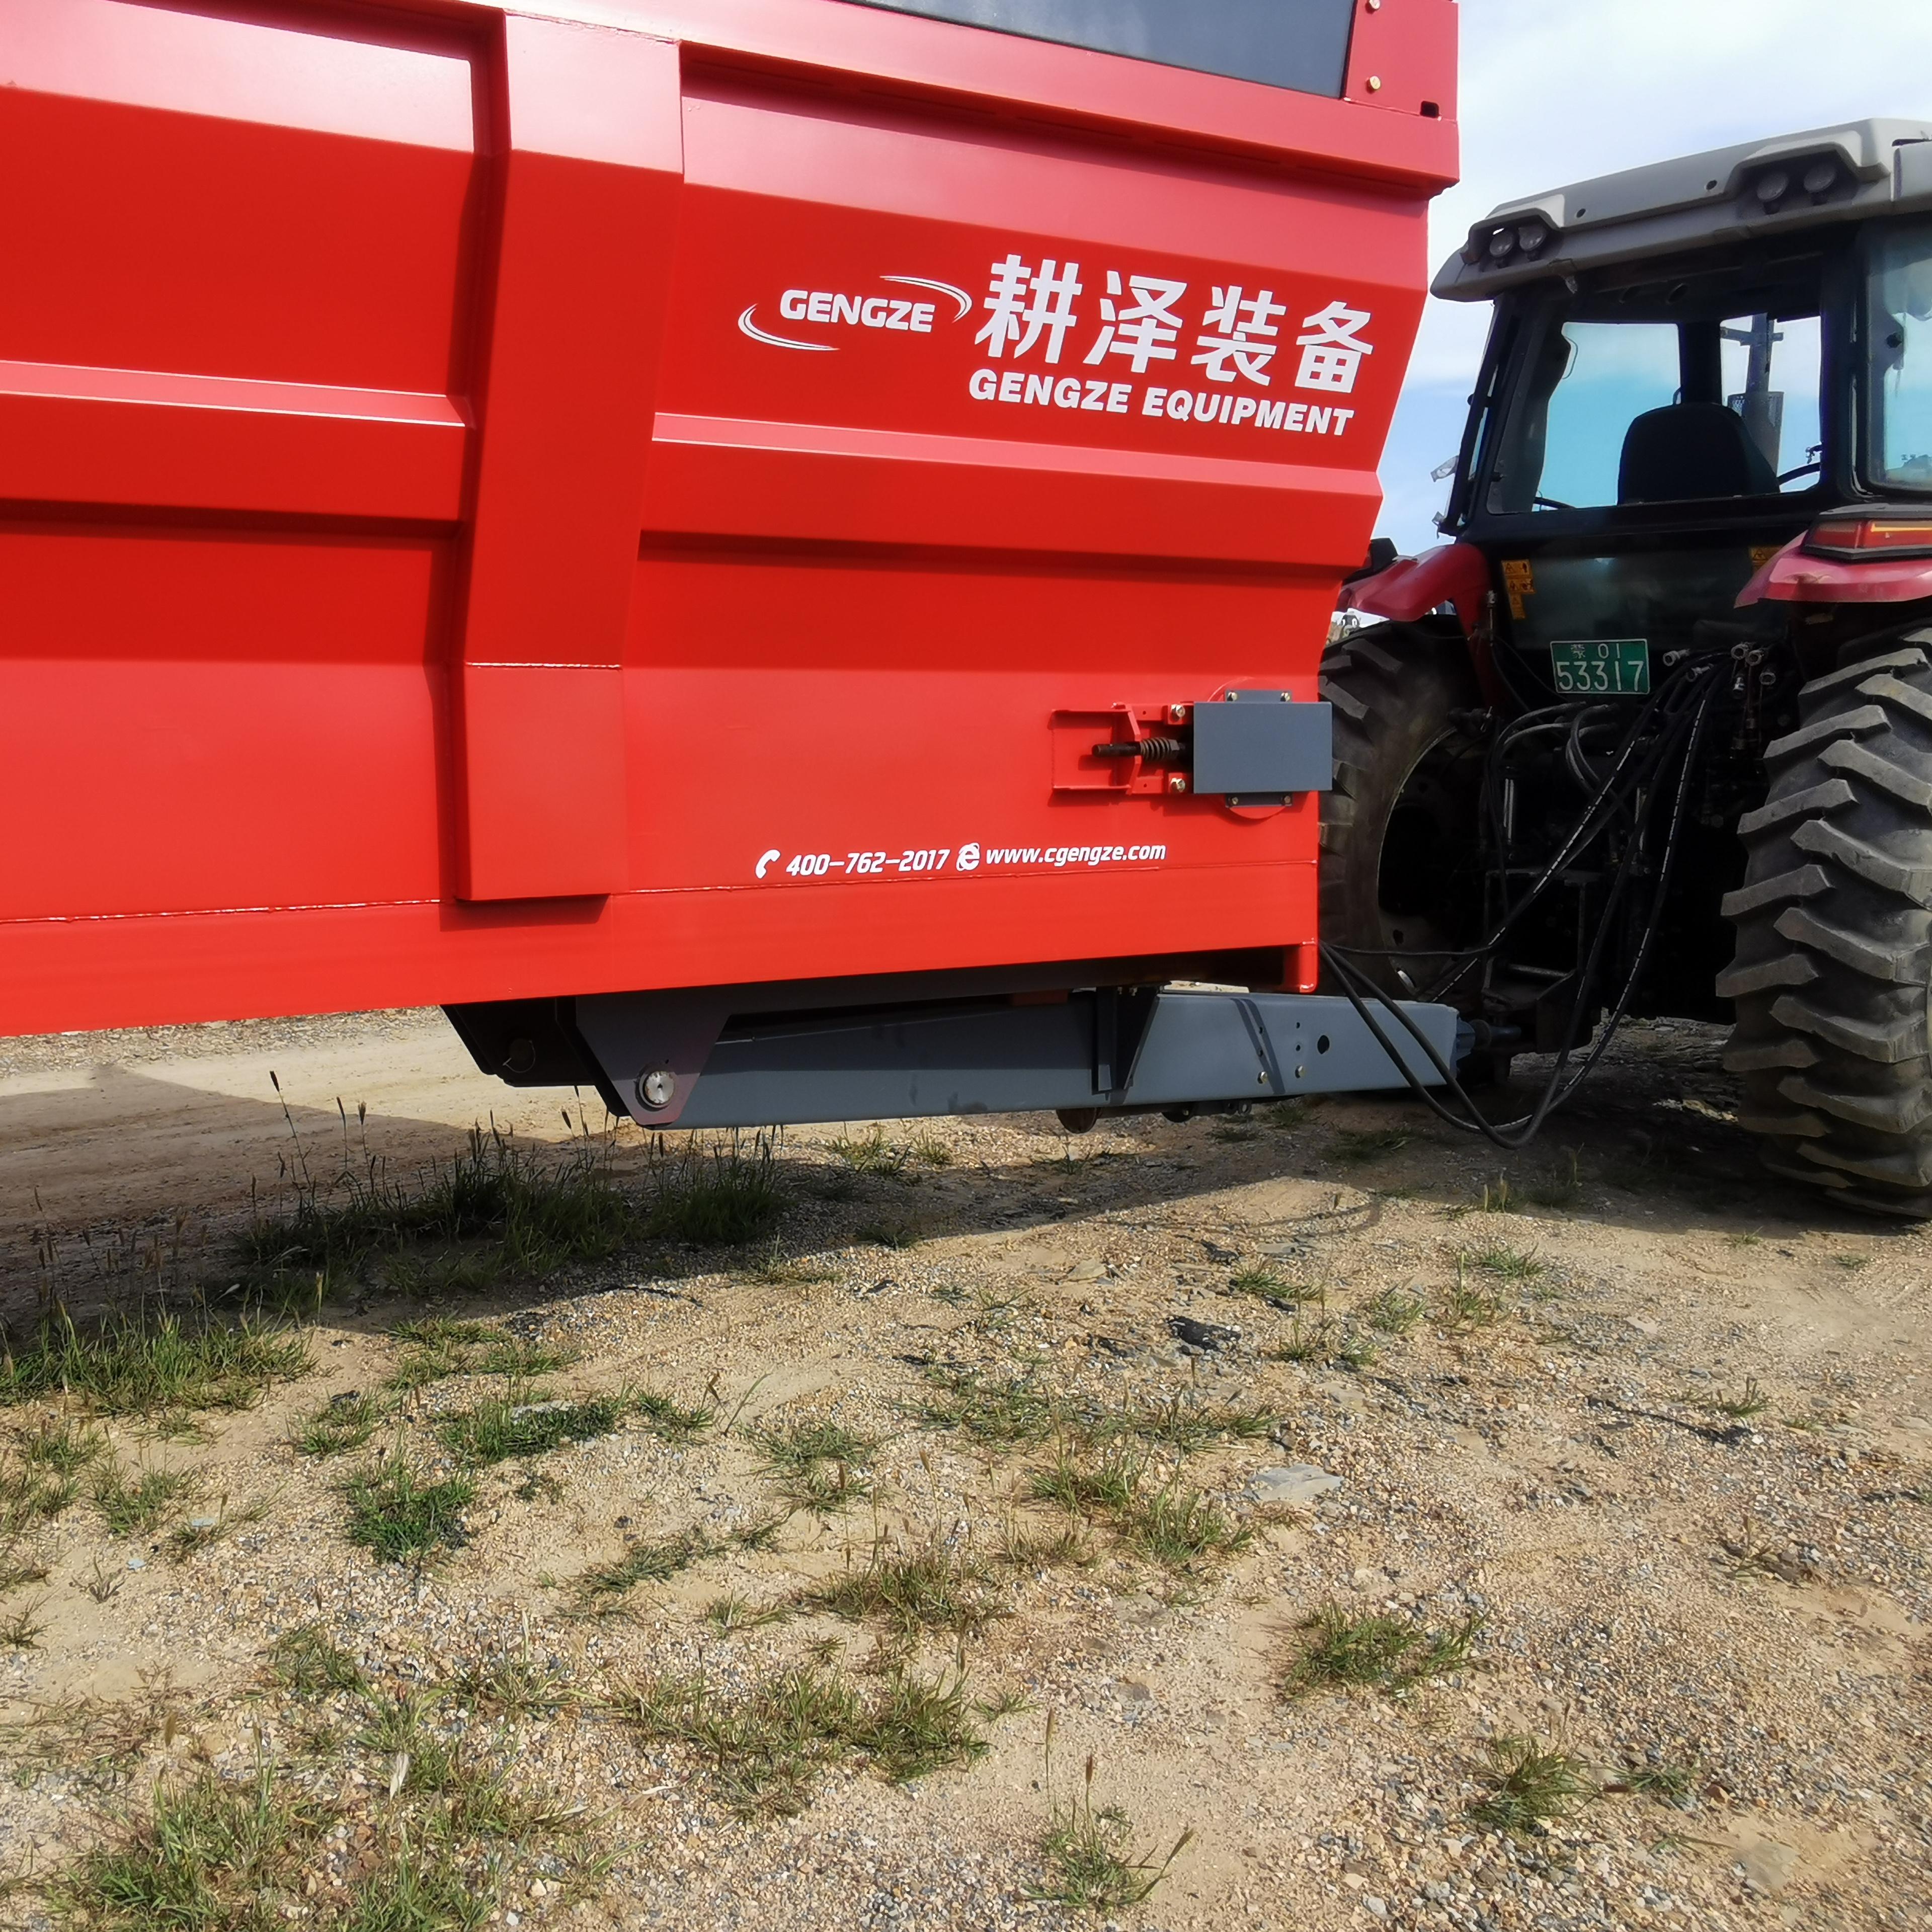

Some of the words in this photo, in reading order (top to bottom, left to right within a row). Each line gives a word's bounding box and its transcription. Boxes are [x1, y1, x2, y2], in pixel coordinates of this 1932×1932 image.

[779, 289, 936, 333] GENGZE
[974, 254, 1374, 394] 耕泽装备
[969, 368, 1133, 414] GENGZE
[1141, 386, 1354, 436] EQUIPMENT
[1556, 661, 1644, 692] 53317
[785, 849, 950, 876] 400-762-2017
[986, 845, 1166, 867] www.cgengze.com
